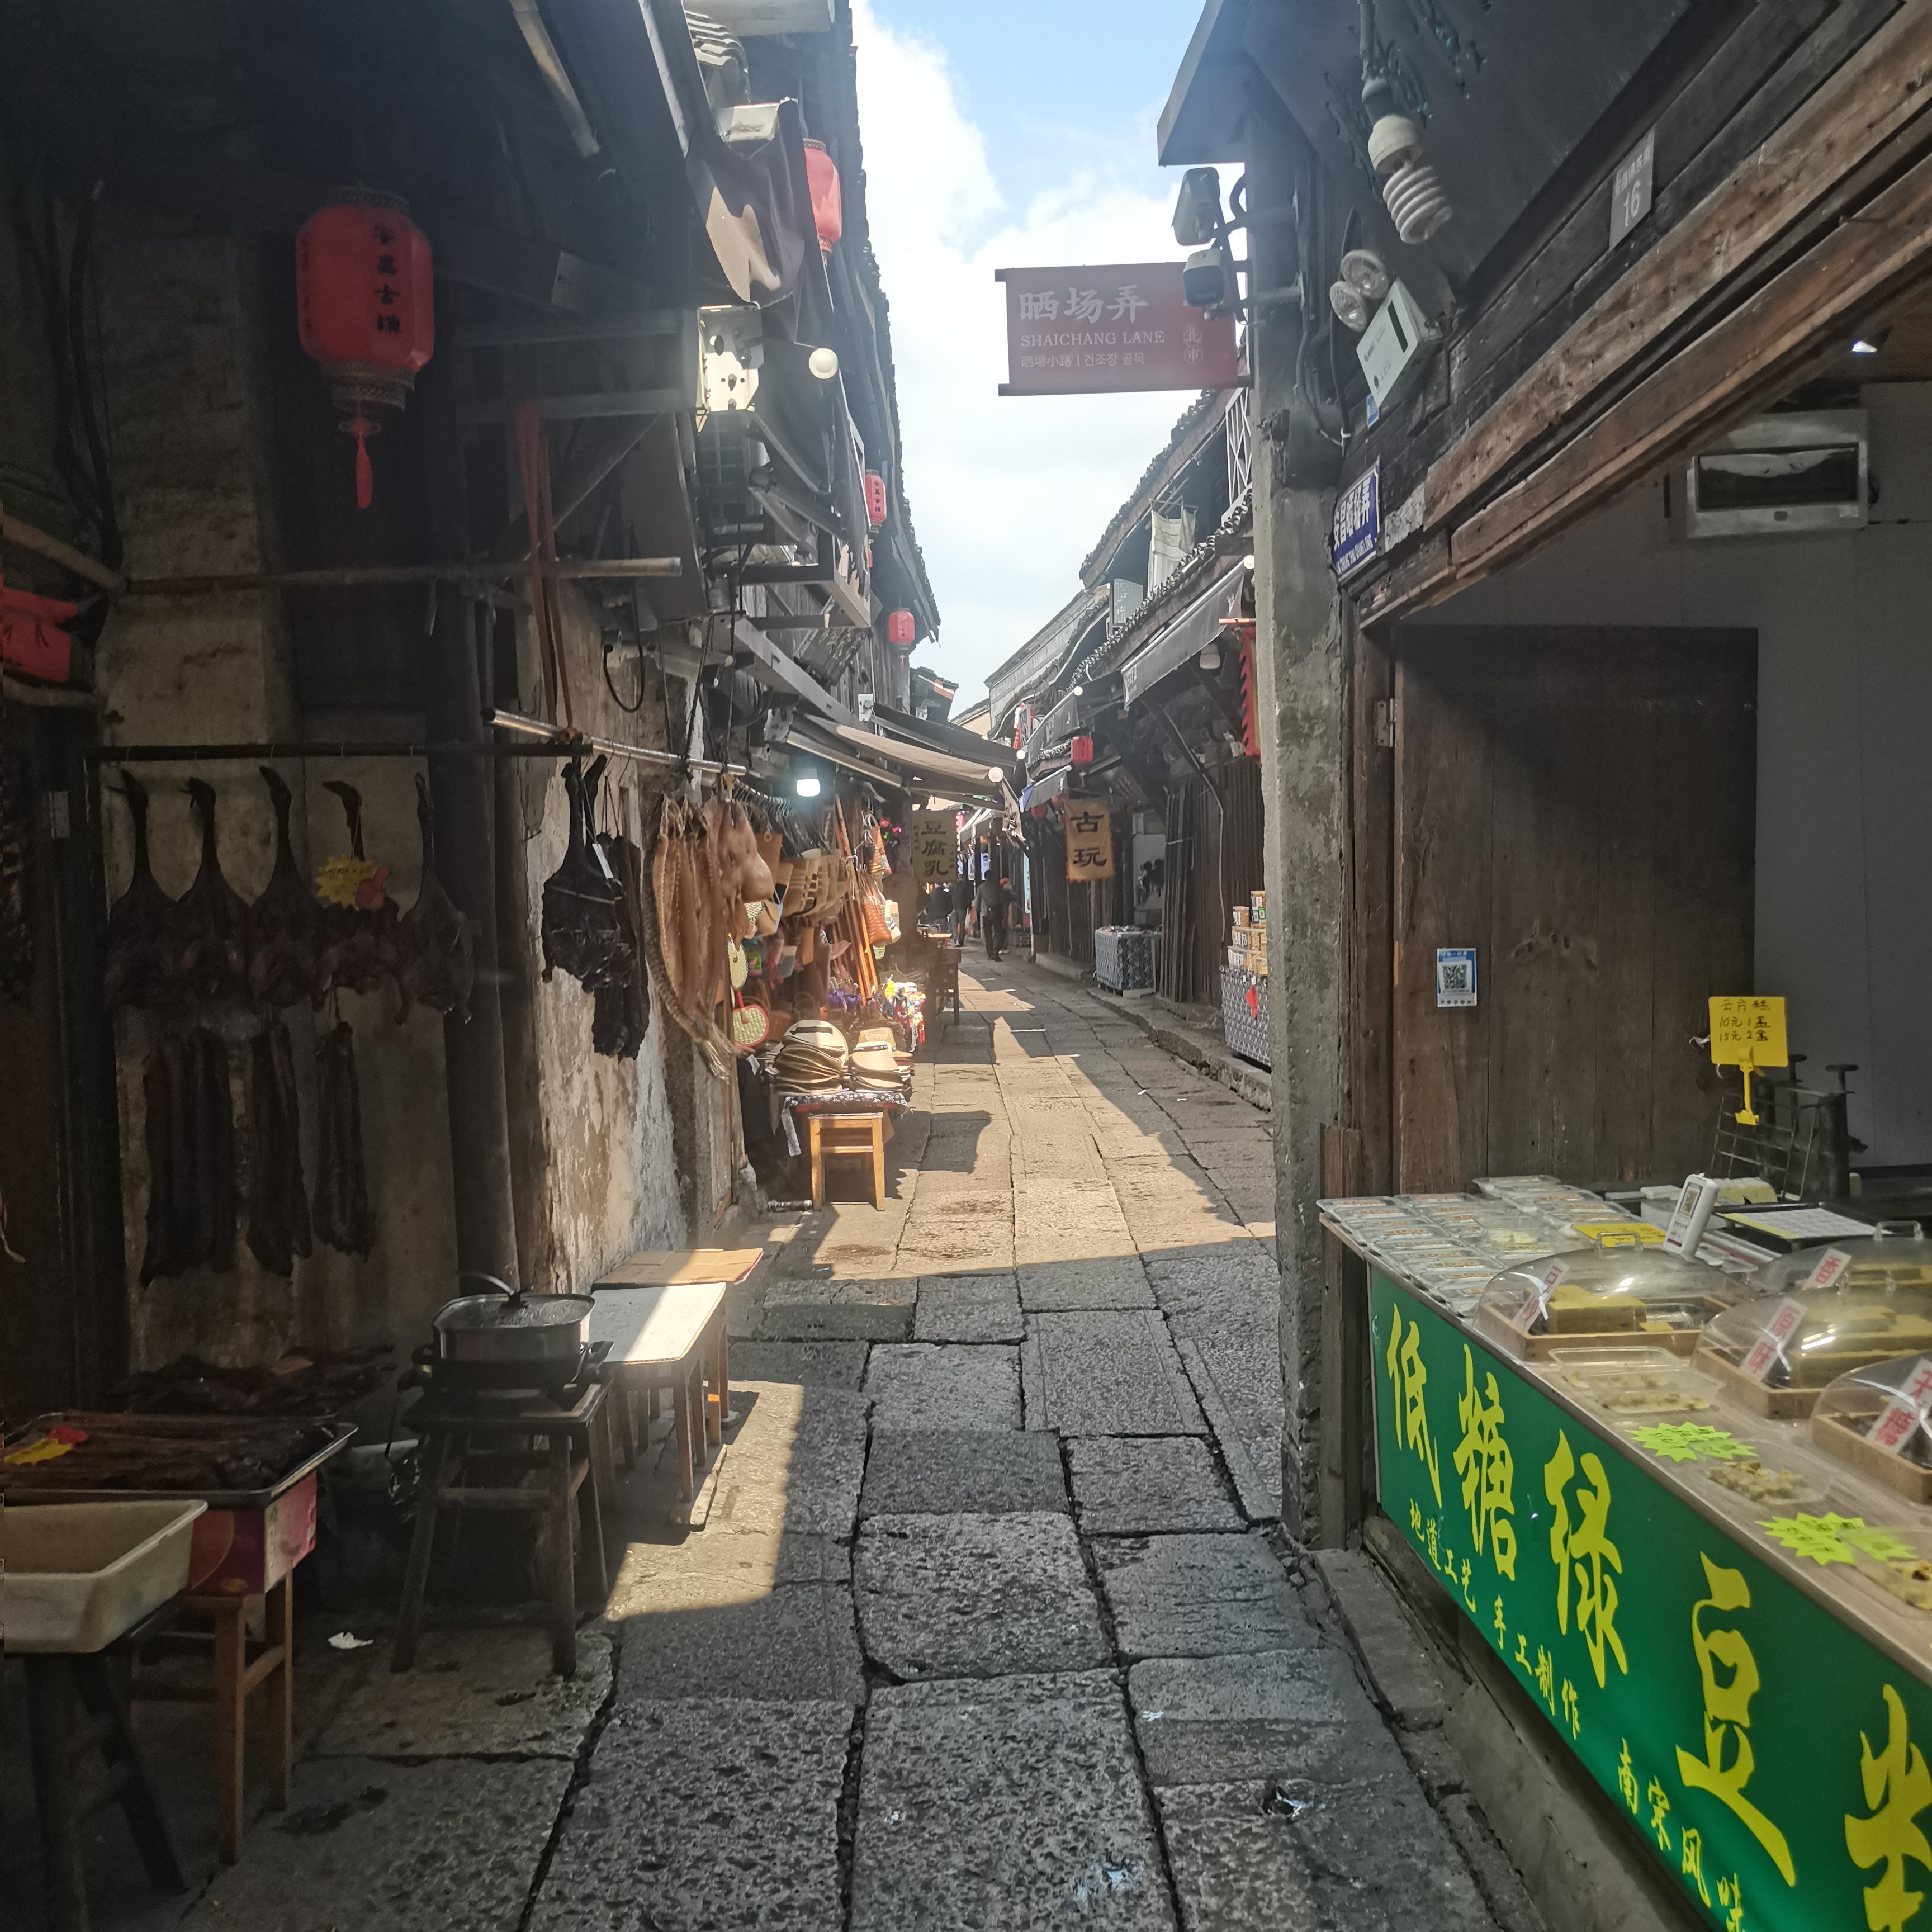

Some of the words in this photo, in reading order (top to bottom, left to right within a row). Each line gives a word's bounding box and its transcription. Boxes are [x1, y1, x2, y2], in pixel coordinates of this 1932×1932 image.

[1623, 180, 1641, 228] 16
[1019, 285, 1148, 323] 晒场弄
[1021, 332, 1117, 347] SHAICHANG
[1123, 330, 1166, 344] LANE
[1083, 352, 1118, 367] 건조장
[1122, 352, 1145, 366] 골목
[1070, 811, 1108, 867] 古玩
[1748, 1306, 1801, 1374] 原味
